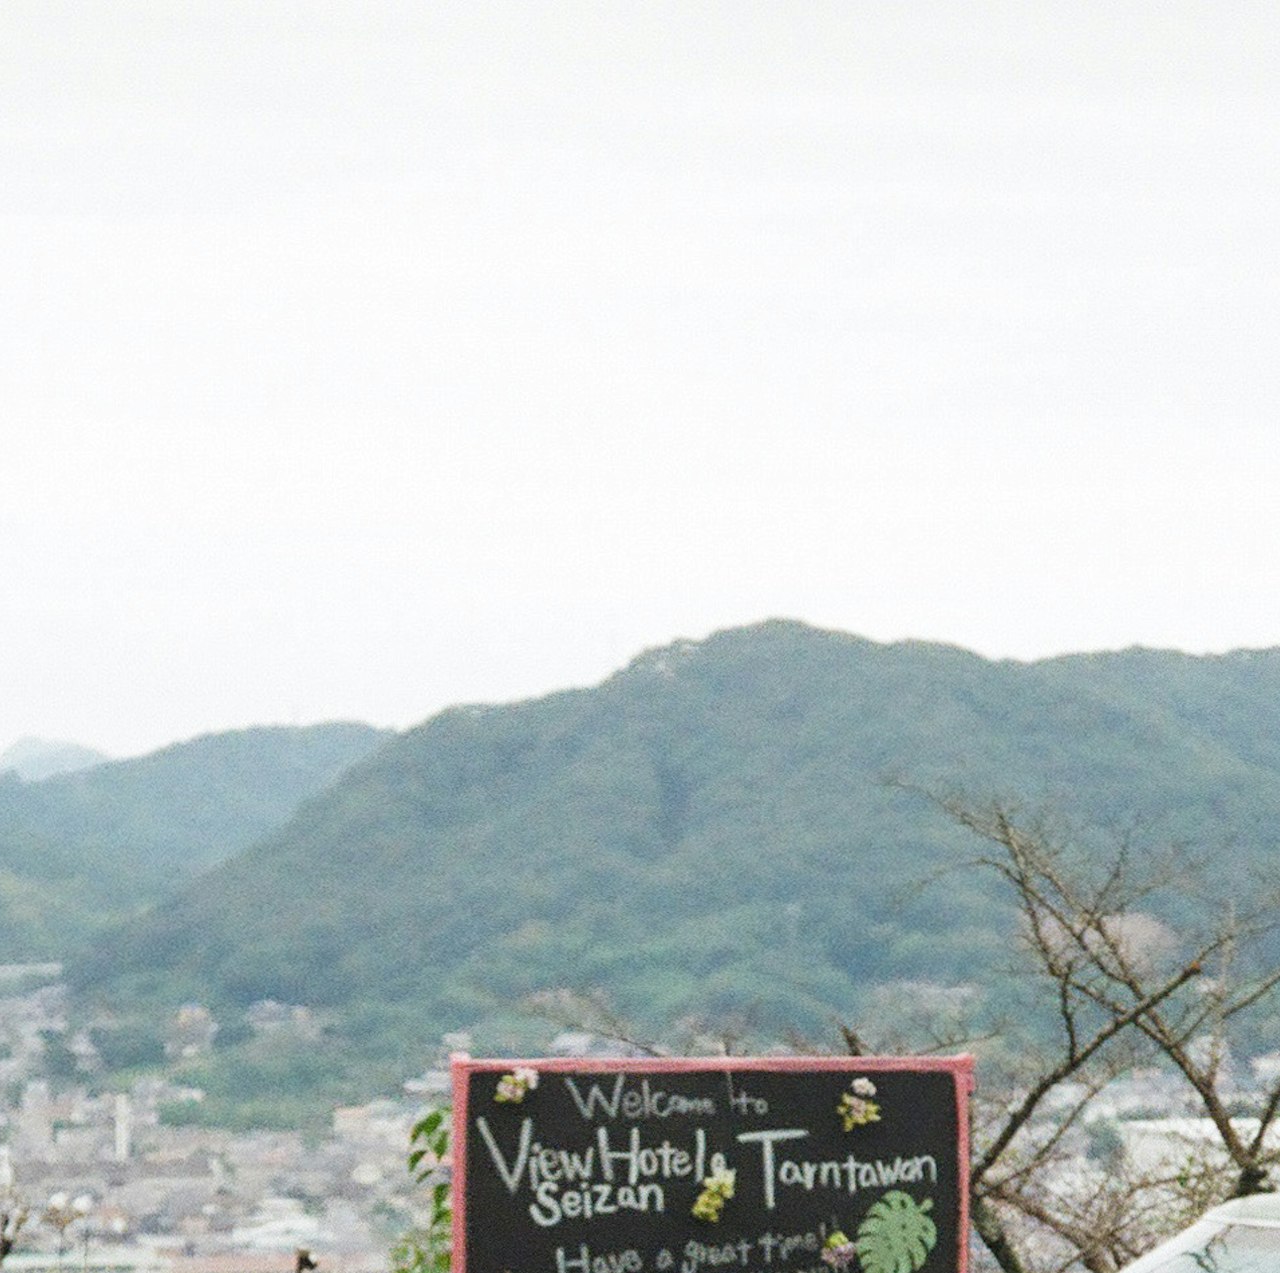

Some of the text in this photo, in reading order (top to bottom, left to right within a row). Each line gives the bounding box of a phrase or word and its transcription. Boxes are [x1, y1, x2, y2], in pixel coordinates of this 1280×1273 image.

[563, 1071, 769, 1121] Welcome to
[477, 1115, 596, 1194] View
[596, 1125, 707, 1185] Hotel
[736, 1128, 938, 1209] Tarntawan
[529, 1182, 665, 1227] Seizan
[655, 1247, 673, 1271] a
